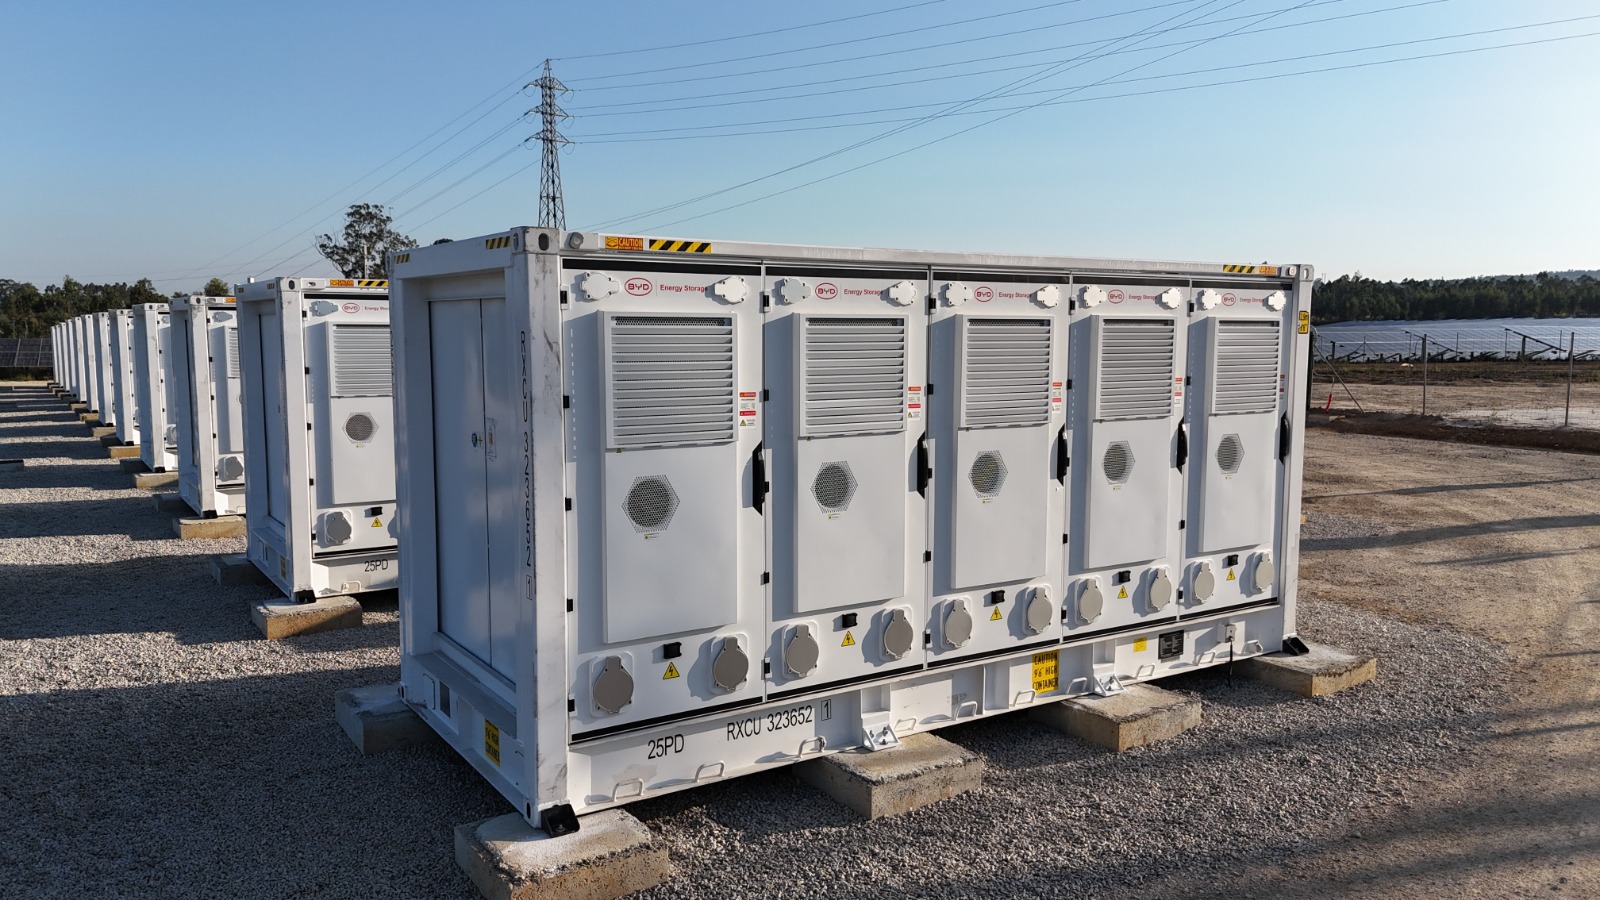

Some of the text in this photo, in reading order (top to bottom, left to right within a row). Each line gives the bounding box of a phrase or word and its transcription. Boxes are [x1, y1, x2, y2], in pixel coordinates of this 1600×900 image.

[618, 237, 643, 247] CAUTION
[660, 284, 683, 292] Energy
[844, 288, 862, 296] Energy
[998, 291, 1014, 299] Energy
[1128, 293, 1143, 301] Energy
[520, 330, 528, 423] RXCU
[523, 431, 532, 567] 323652
[364, 559, 389, 572] 25PD
[1034, 651, 1058, 666] CAUTION
[1045, 664, 1058, 676] HIGH
[1032, 677, 1059, 691] CONTAINER
[727, 716, 762, 741] RXCU
[766, 704, 813, 732] 323652
[647, 733, 685, 760] 25PD
